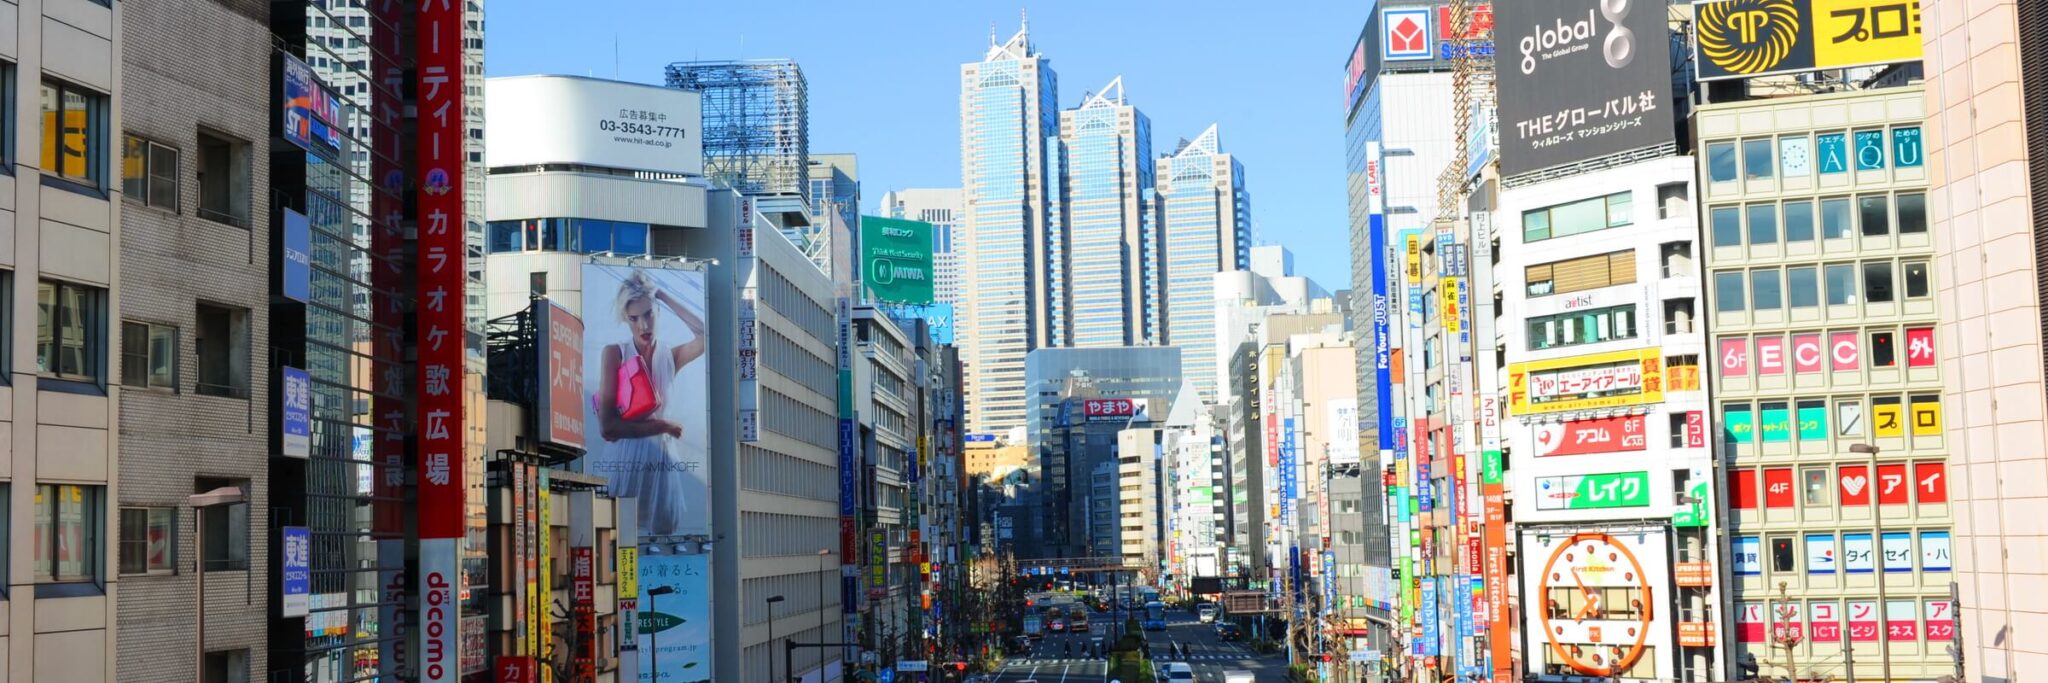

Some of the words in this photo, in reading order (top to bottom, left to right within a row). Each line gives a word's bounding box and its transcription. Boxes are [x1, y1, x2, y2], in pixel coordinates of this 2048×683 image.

[1831, 3, 1921, 44] プロ
[1520, 9, 1596, 75] global
[1541, 52, 1553, 61] The
[1553, 47, 1571, 58] Global
[1571, 43, 1589, 54] Group
[619, 108, 666, 122] 広告募集中
[1516, 90, 1656, 140] THEグローバル社
[600, 118, 686, 139] 03-3543-7771
[1532, 131, 1574, 149] ウィルローズ
[1577, 116, 1642, 139] マンションシリーズ
[613, 135, 672, 149] www.hit-ad.co.jp
[1367, 160, 1376, 184] LABI
[1476, 212, 1486, 249] 村上ビル
[872, 247, 889, 256] Think
[894, 266, 924, 280] MIWA
[1374, 294, 1386, 326] JUST
[425, 208, 450, 486] カラオケ歌広場
[1378, 331, 1387, 353] Your
[1910, 337, 1933, 359] 外
[1378, 354, 1388, 369] For
[1723, 348, 1747, 369] 6F
[1761, 340, 1858, 368] ECC
[1559, 373, 1640, 393] エーアイアール
[1641, 358, 1662, 394] 賃貸
[286, 375, 308, 410] 東進
[1088, 401, 1130, 413] やまや
[1484, 398, 1497, 427] アコム
[1624, 420, 1640, 433] 6F
[1689, 413, 1702, 446] アコム
[1878, 409, 1936, 430] プロ
[1576, 427, 1611, 445] アコム
[1487, 453, 1499, 480] レイク
[1588, 478, 1640, 502] レイク
[1769, 482, 1790, 494] 4F
[1881, 472, 1941, 495] アイ
[286, 535, 308, 568] 東進
[1489, 547, 1498, 575] First
[1735, 552, 1758, 564] 賃貸
[574, 556, 591, 599] 指圧
[620, 601, 636, 610] KM
[1490, 576, 1500, 622] Kitchen
[427, 572, 449, 681] docomo
[639, 617, 670, 628] RESYLE
